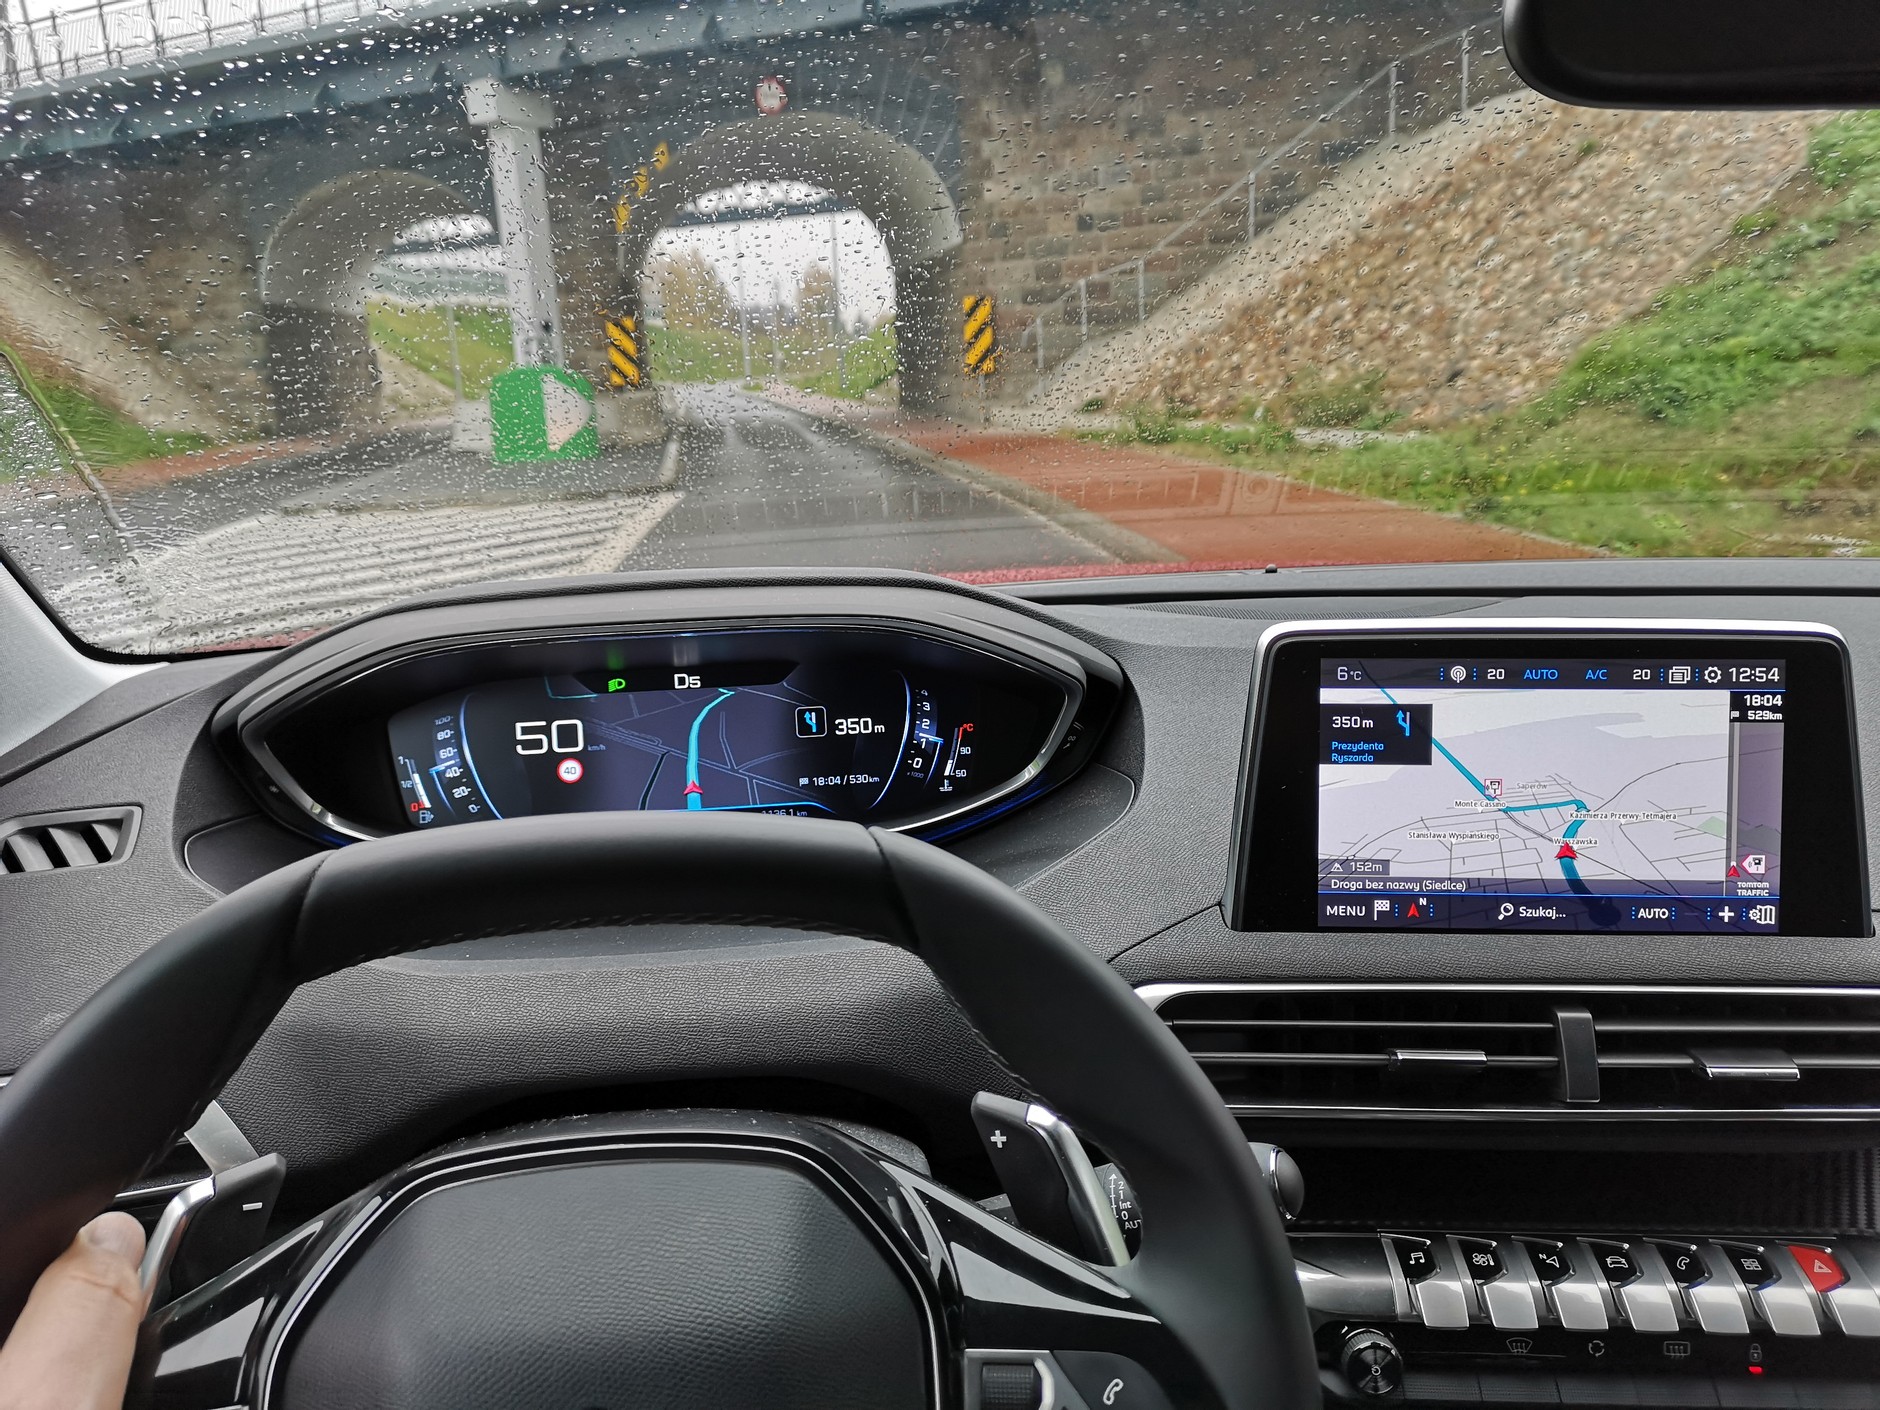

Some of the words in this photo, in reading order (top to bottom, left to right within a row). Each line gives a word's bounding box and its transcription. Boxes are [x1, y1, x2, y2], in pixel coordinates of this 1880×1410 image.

[1487, 668, 1505, 680] 20
[1523, 669, 1558, 680] AUTO
[1585, 669, 1608, 680] A/C
[1632, 669, 1651, 680] 20
[1728, 667, 1780, 683] 12:54
[1744, 694, 1783, 706] 18:04
[922, 702, 931, 711] 3
[921, 719, 930, 729] 2
[437, 729, 451, 740] 80
[515, 719, 584, 755] 50
[920, 738, 927, 749] 1
[1331, 741, 1384, 752] Prezydenta
[439, 747, 454, 759] 60
[960, 747, 971, 755] 90
[912, 757, 923, 769] 0
[1331, 753, 1374, 764] Ryszarda
[445, 767, 461, 778] 40
[563, 766, 577, 775] 40
[955, 769, 967, 777] 50
[812, 776, 841, 786] 18:04
[452, 786, 469, 799] 20
[410, 803, 419, 812] 0
[1455, 800, 1479, 808] Monte
[1479, 800, 1506, 808] Cassino
[1569, 812, 1608, 820] Kazimierza
[1408, 831, 1447, 840] Stanisława
[1448, 831, 1500, 842] Wyspiańskiego
[1331, 880, 1363, 891] Droga
[1365, 880, 1384, 890] bez
[1386, 882, 1420, 892] nazwy
[1422, 881, 1467, 891] (Siedlce)
[1326, 906, 1366, 916] MENU
[1519, 906, 1566, 919] Szukaj...
[1637, 908, 1669, 919] AUTO
[1118, 1181, 1124, 1189] 2
[1119, 1190, 1124, 1199] 1
[1119, 1201, 1132, 1209] Int
